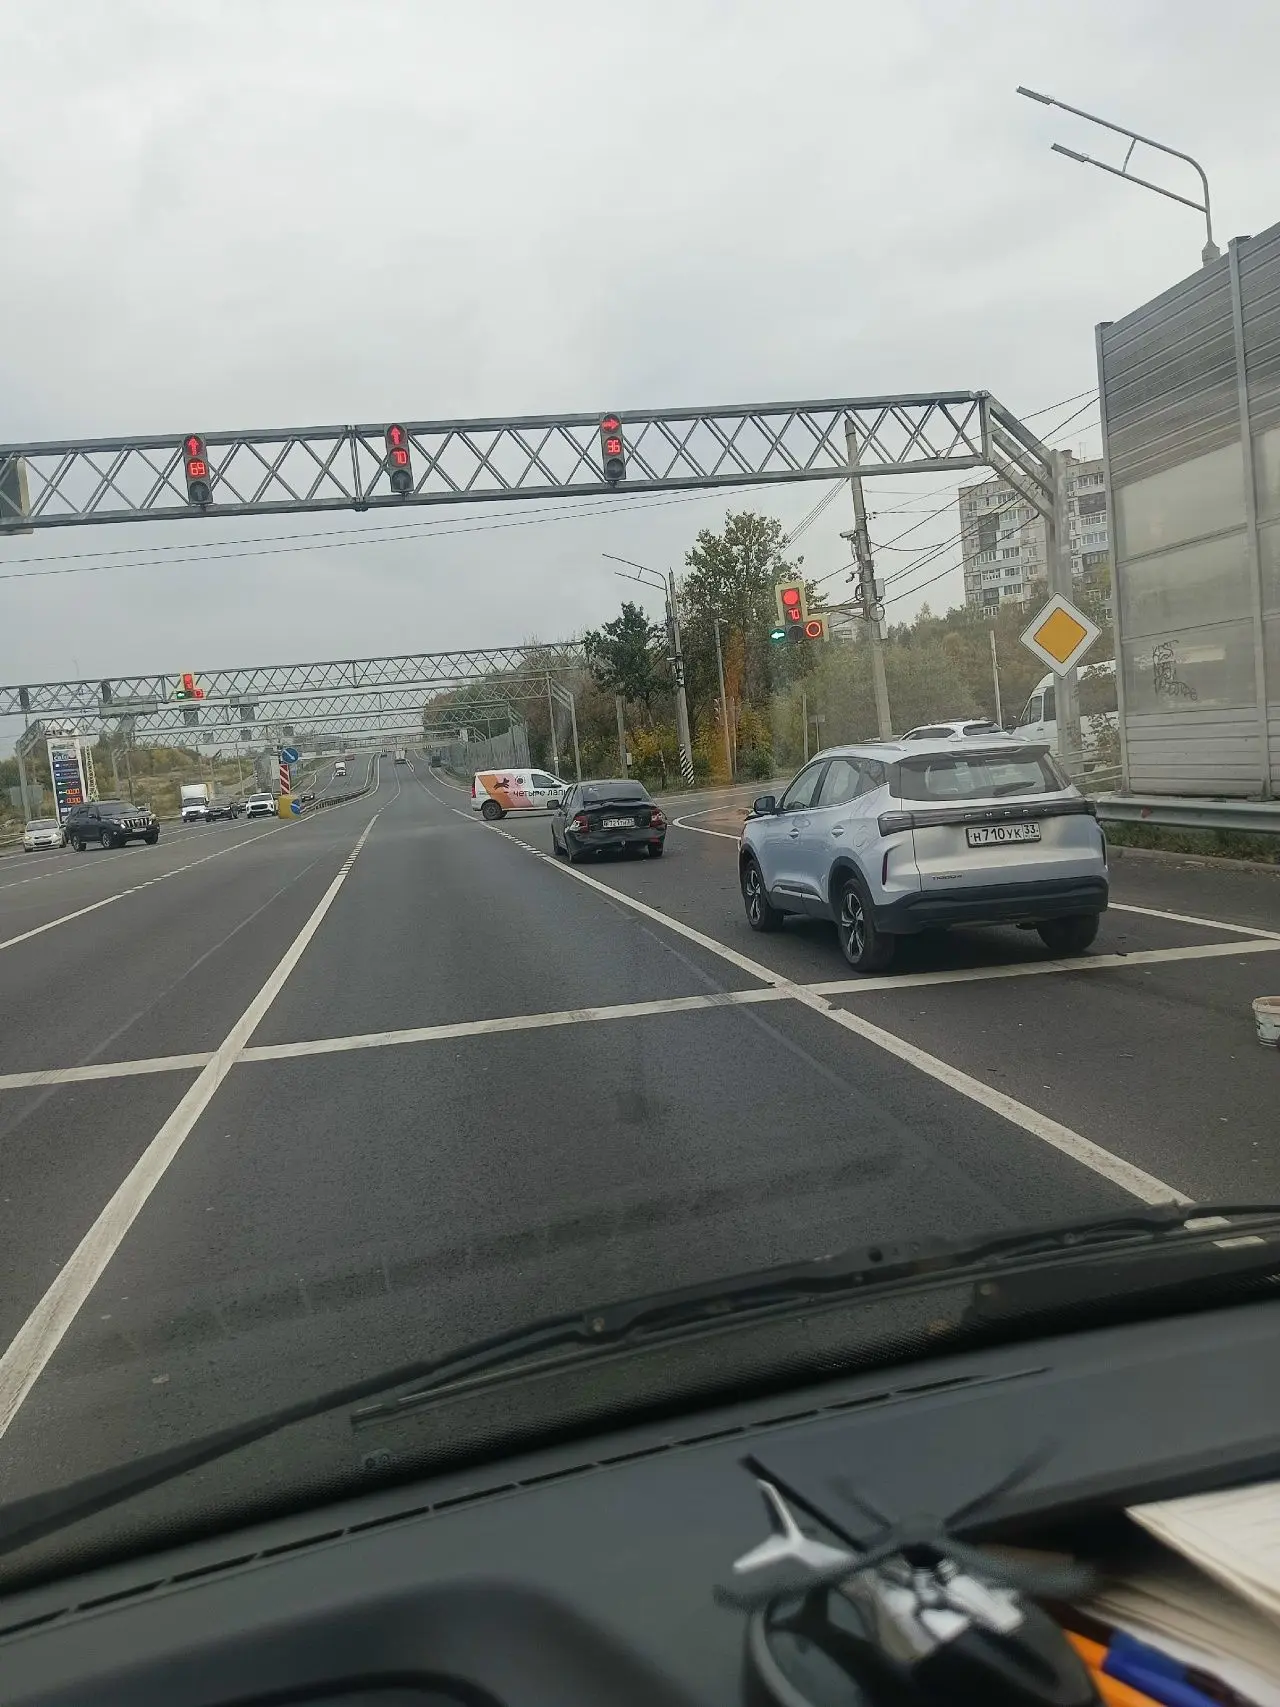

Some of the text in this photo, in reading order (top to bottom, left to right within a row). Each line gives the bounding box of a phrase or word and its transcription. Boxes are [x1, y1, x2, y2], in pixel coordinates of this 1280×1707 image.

[392, 450, 407, 464] 70
[190, 462, 206, 476] 69
[788, 608, 800, 621] 70
[1023, 824, 1036, 835] 33
